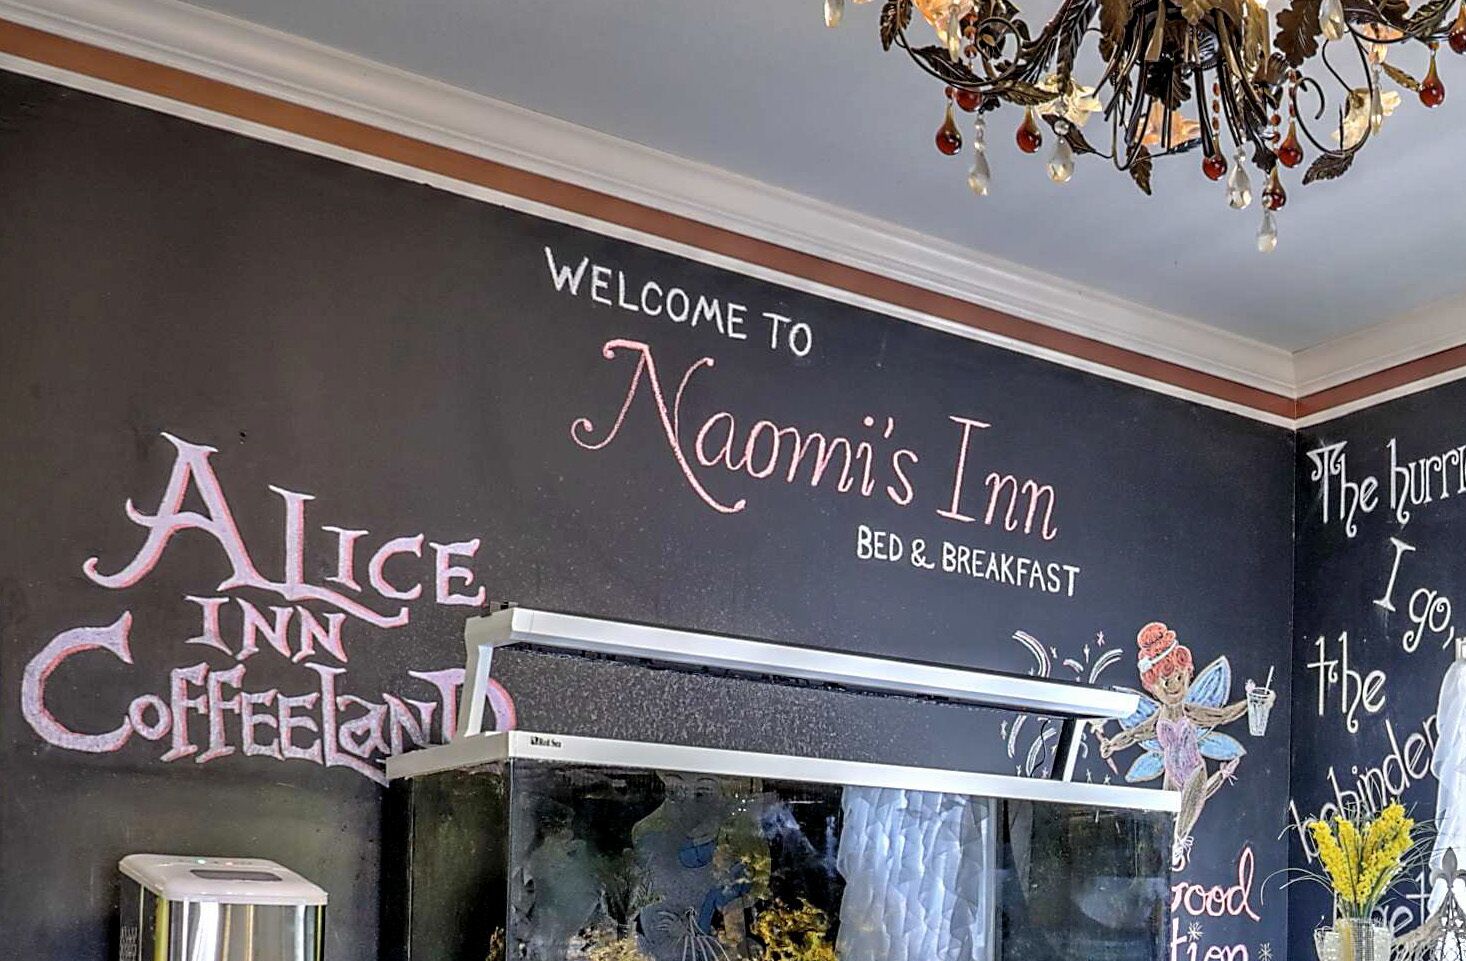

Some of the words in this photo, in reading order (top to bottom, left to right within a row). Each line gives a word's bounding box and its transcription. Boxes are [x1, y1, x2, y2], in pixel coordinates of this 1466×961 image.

[544, 246, 748, 339] WELCOME
[763, 312, 813, 357] TO
[570, 338, 919, 513] Naomi's
[936, 416, 1058, 540] Inn
[1306, 440, 1378, 538] The
[82, 430, 486, 628] ALICE
[856, 525, 903, 561] BED
[910, 538, 935, 570] &
[942, 541, 1080, 597] BREAKFAST
[185, 594, 348, 663] INN
[1372, 536, 1416, 613] I
[1402, 588, 1455, 652] go,
[1307, 631, 1387, 732] the
